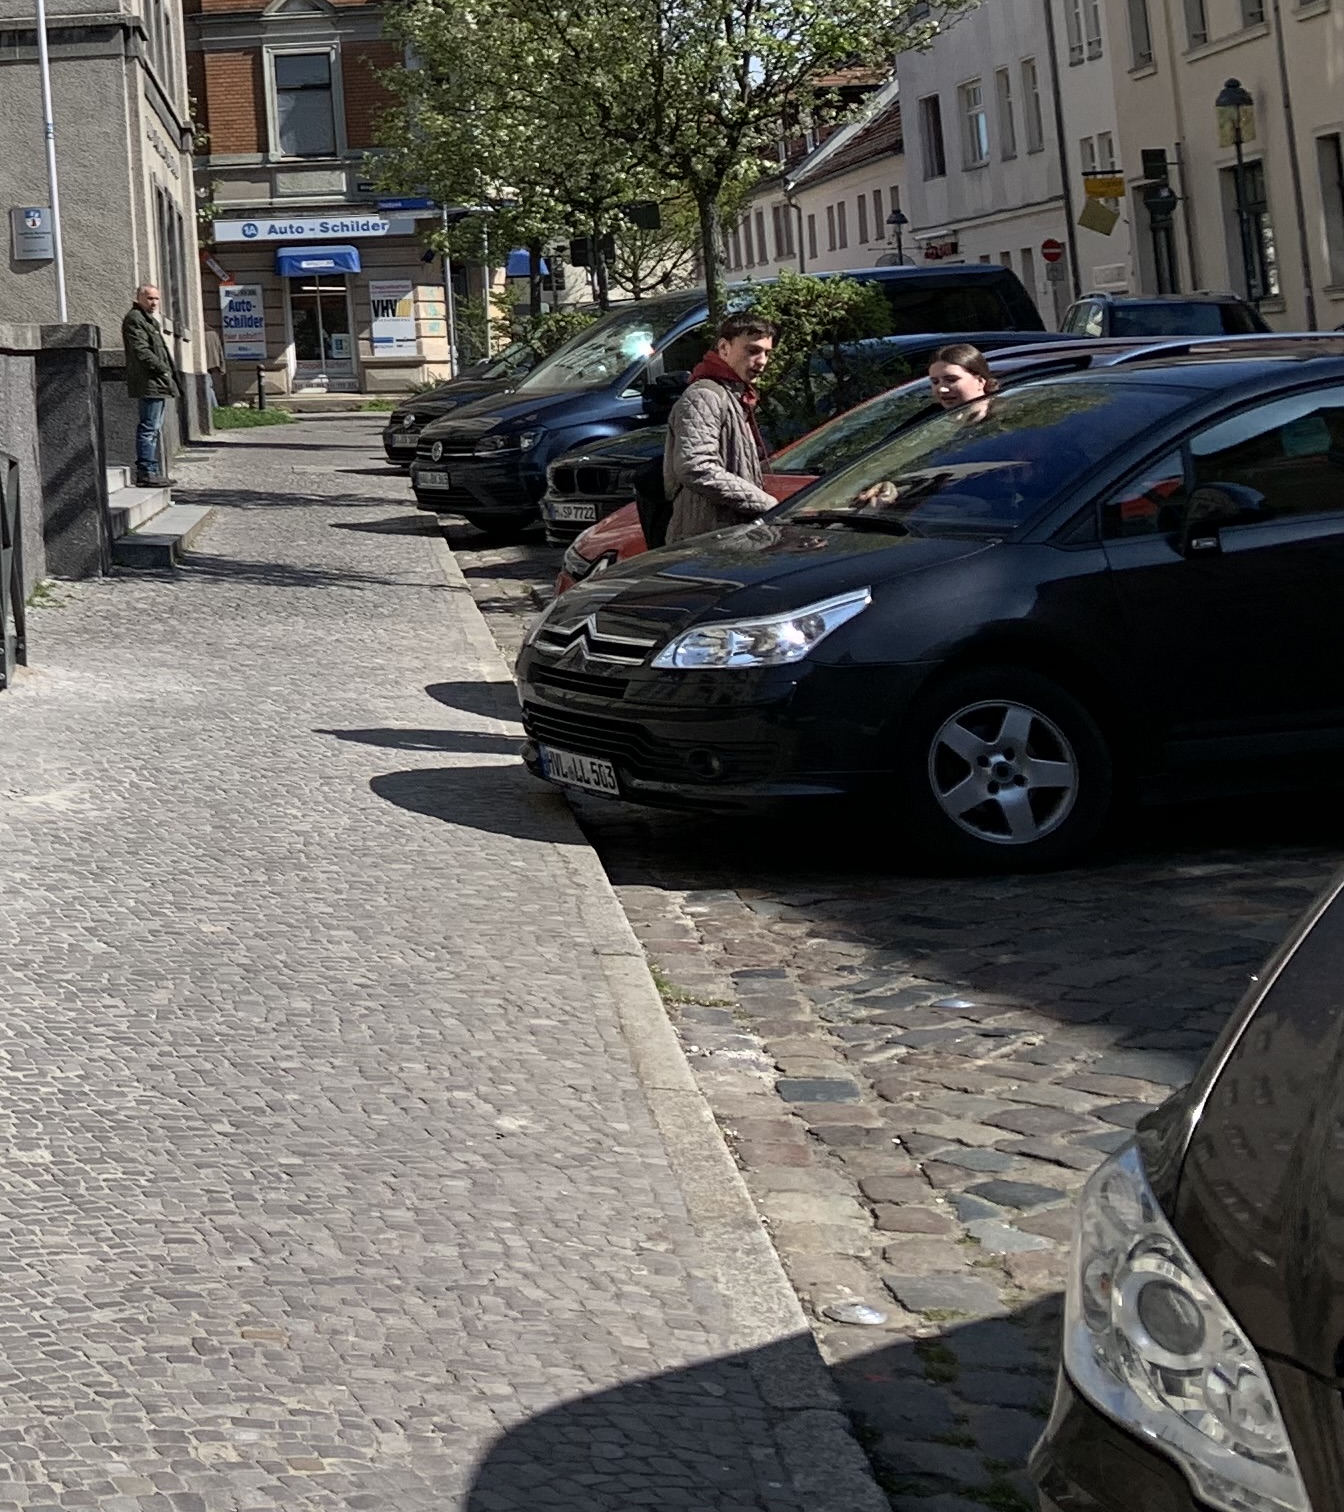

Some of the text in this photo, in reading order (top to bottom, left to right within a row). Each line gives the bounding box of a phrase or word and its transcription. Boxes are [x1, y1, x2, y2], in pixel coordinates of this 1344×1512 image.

[267, 224, 305, 235] Auto
[319, 221, 388, 233] Schilder
[228, 299, 257, 313] Auto-
[372, 299, 398, 318] VHV
[223, 315, 264, 329] Schilder
[573, 506, 594, 519] 7722
[548, 751, 616, 789] HVL LL 503
